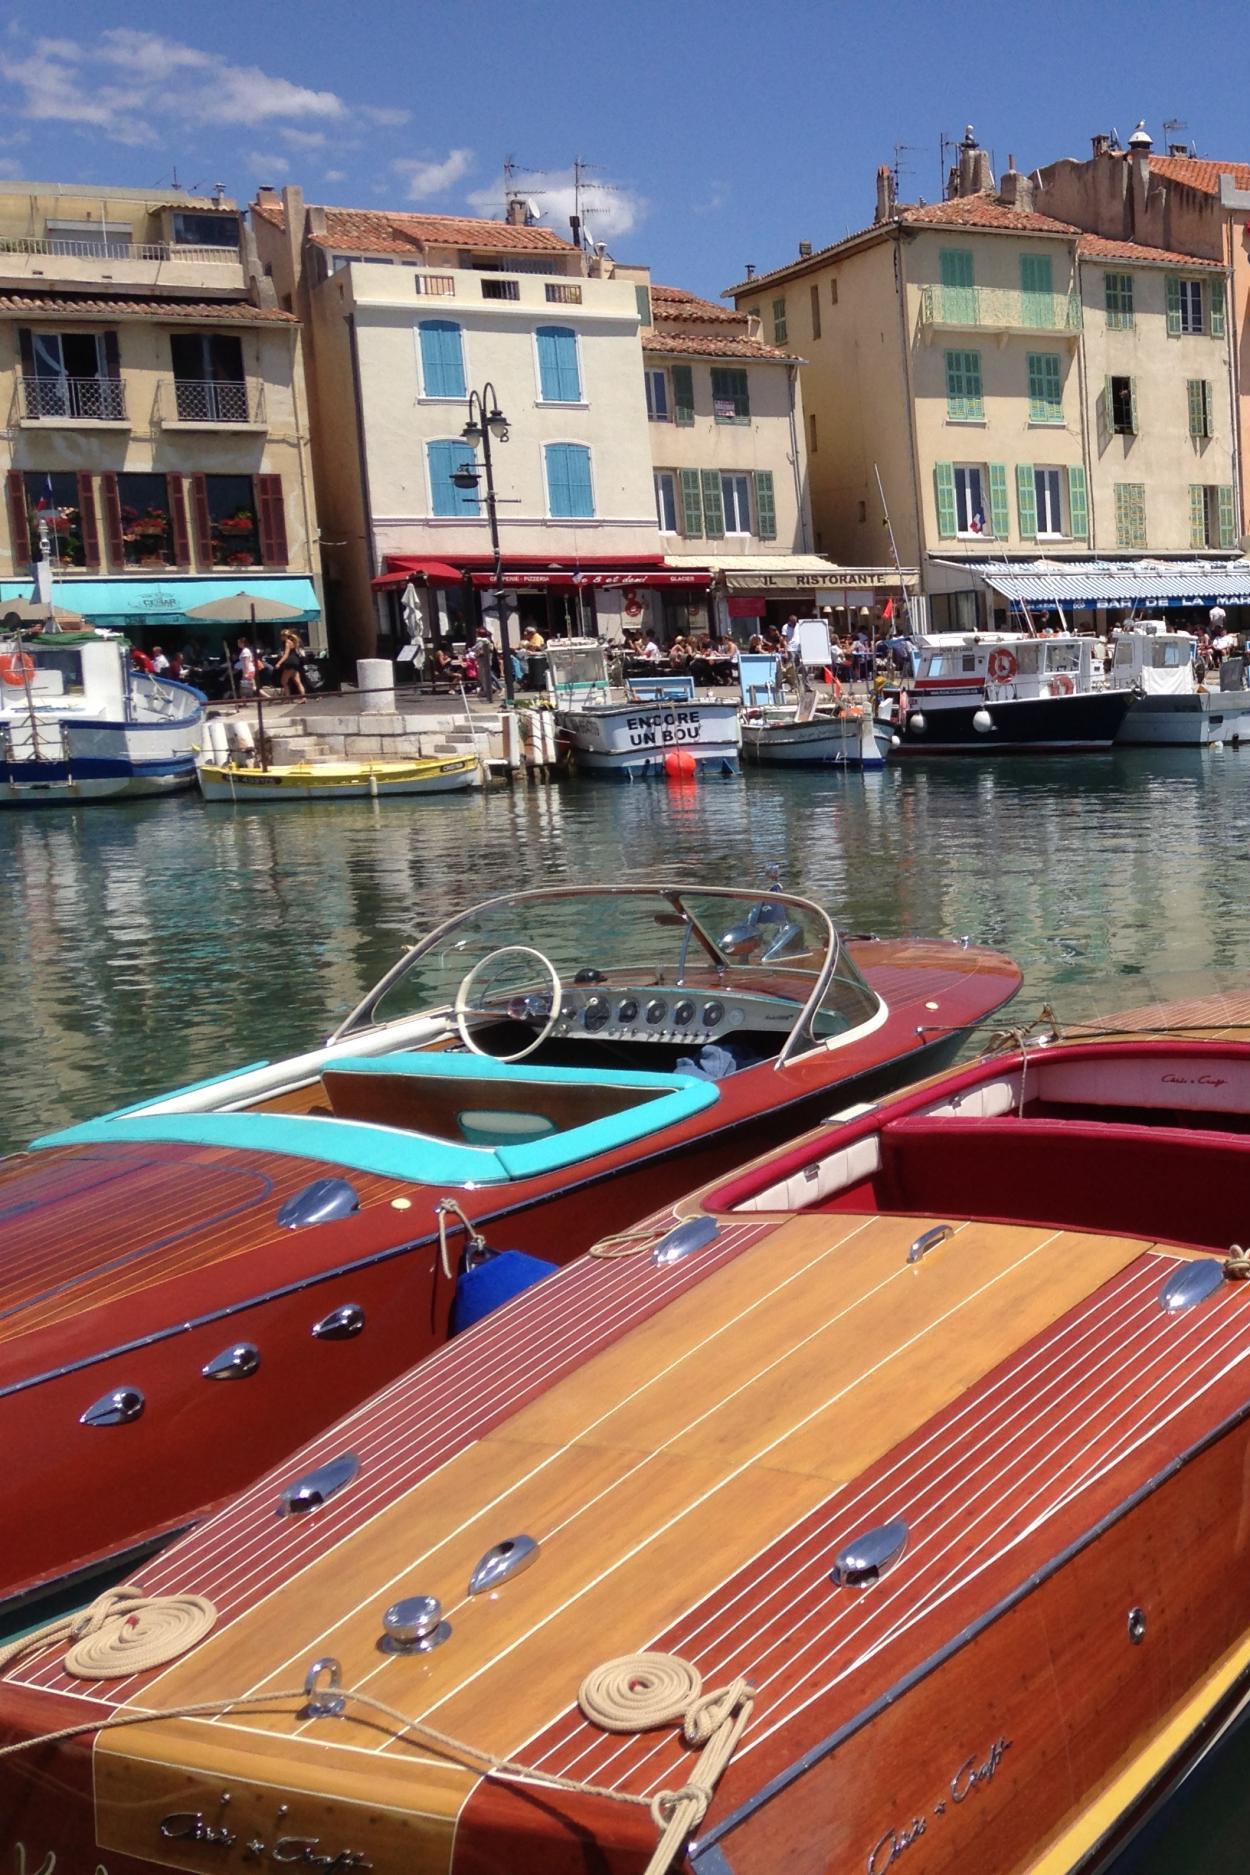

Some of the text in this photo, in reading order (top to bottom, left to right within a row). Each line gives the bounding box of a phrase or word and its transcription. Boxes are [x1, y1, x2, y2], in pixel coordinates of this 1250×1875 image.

[763, 574, 886, 586] IL RISTORANTE
[1096, 598, 1132, 609] BAR
[1145, 598, 1169, 607] DE
[1181, 596, 1205, 606] LA
[627, 711, 700, 730] ENCORE
[630, 732, 656, 746] UN
[950, 1736, 1014, 1803] Craft
[271, 1835, 374, 1873] Craft
